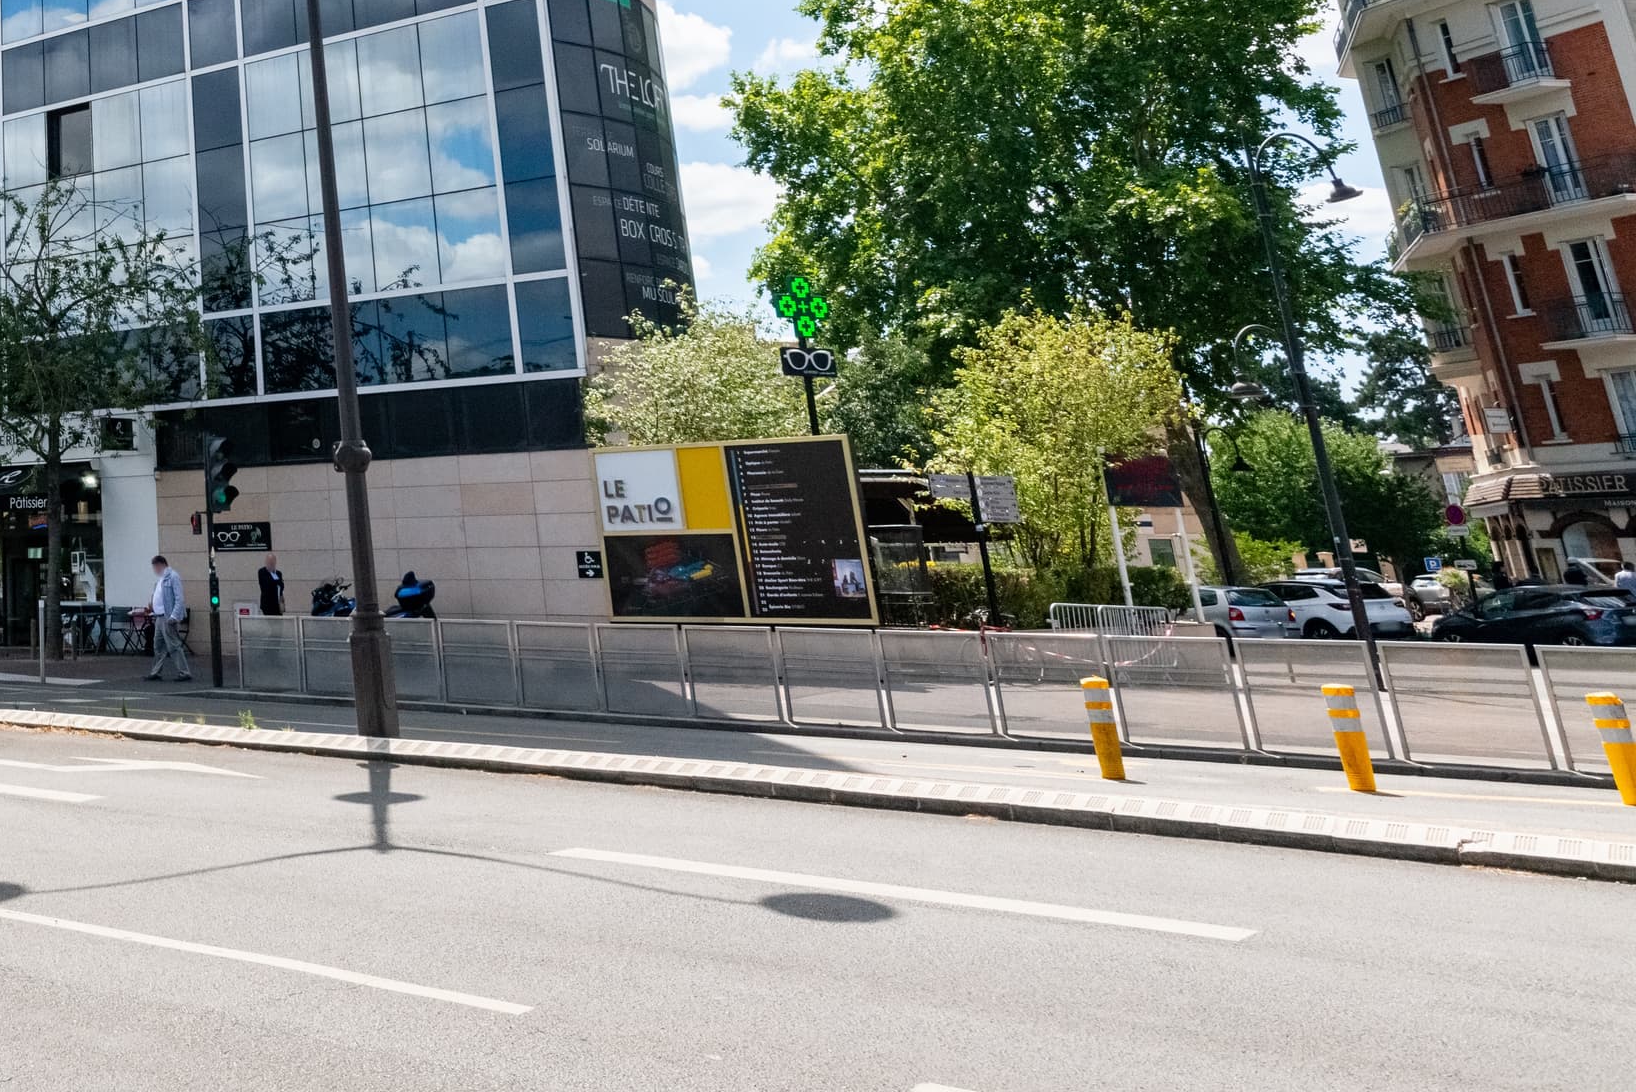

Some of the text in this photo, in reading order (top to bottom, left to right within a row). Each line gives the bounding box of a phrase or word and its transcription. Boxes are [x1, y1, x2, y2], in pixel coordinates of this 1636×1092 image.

[600, 63, 639, 101] THE
[586, 137, 635, 158] SOLARIUM
[622, 195, 660, 218] DÉTENTE
[620, 218, 646, 240] BOX
[604, 479, 626, 498] LE
[9, 496, 49, 510] Pâtissier
[606, 497, 673, 524] PATIO
